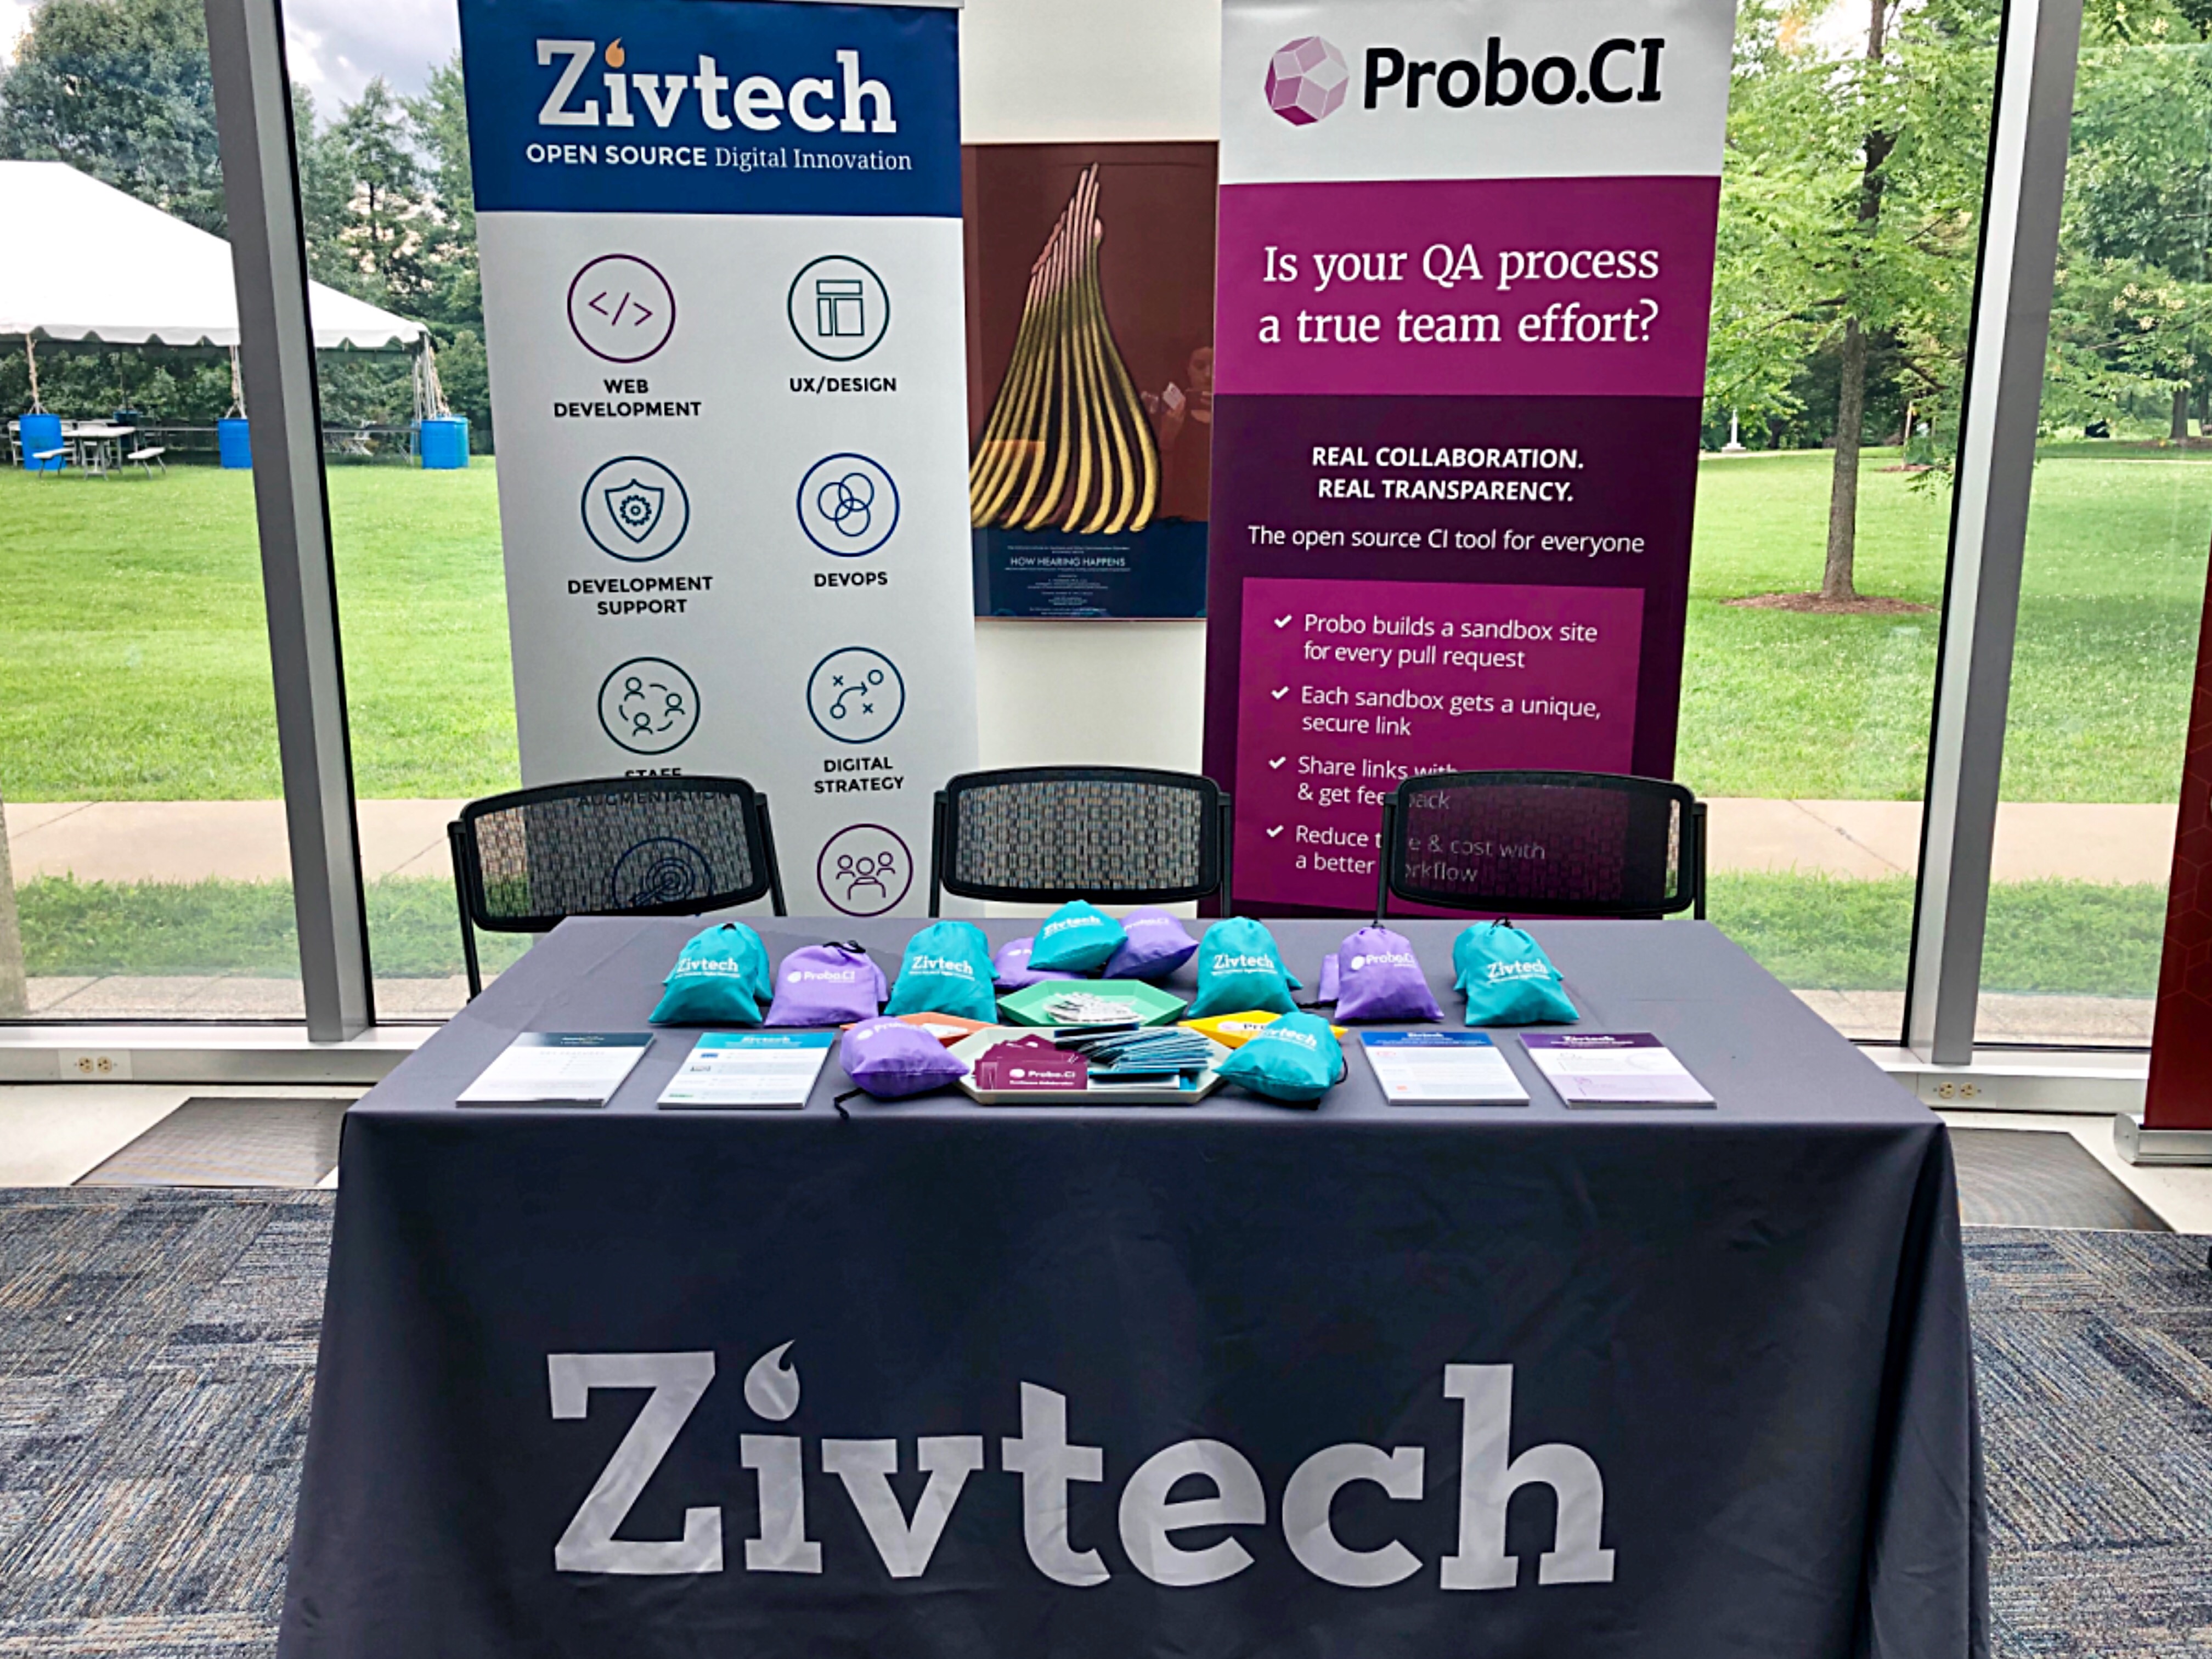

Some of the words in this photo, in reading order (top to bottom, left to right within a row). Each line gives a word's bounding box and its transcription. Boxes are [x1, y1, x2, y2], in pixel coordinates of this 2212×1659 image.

[1364, 37, 1664, 109] Probo.CI
[537, 38, 897, 133] Zivtech
[526, 144, 597, 165] OPEN
[605, 145, 707, 167] SOURCE
[715, 148, 787, 172] Digital
[794, 149, 912, 171] Innovation
[1263, 247, 1298, 281] Is
[1314, 251, 1407, 291] your
[1423, 244, 1482, 287] QA
[1497, 250, 1659, 290] process
[1259, 315, 1280, 342] a
[1297, 309, 1380, 343] true
[1397, 308, 1502, 342] team
[1518, 299, 1659, 342] effort?
[604, 380, 648, 394] WEB
[789, 377, 897, 393] UX/DESIGN
[554, 402, 701, 417] DEVELOPMENT
[1312, 447, 1368, 467] REAL
[1375, 448, 1583, 469] COLLABORATION.
[1318, 479, 1374, 499] REAL
[1383, 481, 1573, 501] TRANSPARENCY.
[1248, 526, 1285, 545] The
[1292, 529, 1344, 550] open
[1352, 531, 1421, 548] source
[1428, 529, 1448, 549] CI
[1455, 529, 1496, 549] tool
[1503, 530, 1534, 550] for
[1541, 534, 1644, 556] everyone
[1011, 557, 1035, 566] HOW
[1037, 557, 1080, 566] HEARING
[1083, 557, 1125, 567] HAPPENS
[568, 577, 713, 595] DEVELOPMENT
[814, 572, 888, 587] DEVOPS
[597, 599, 687, 616] SUPPORT
[1305, 614, 1365, 634] Probo
[1373, 616, 1434, 637] builds
[1442, 623, 1453, 637] a
[1461, 618, 1552, 640] sandbox
[1560, 622, 1598, 642] site
[1305, 640, 1330, 661] for
[1334, 646, 1392, 667] every
[1398, 644, 1436, 666] pull
[1443, 649, 1525, 672] request
[1302, 686, 1348, 707] Each
[1355, 687, 1444, 710] sandbox
[1449, 693, 1494, 715] gets
[1501, 697, 1513, 712] a
[1521, 696, 1601, 720] unique,
[1302, 715, 1369, 734] secure
[1376, 715, 1411, 736] link
[824, 758, 893, 772] DIGITAL
[1298, 756, 1356, 777] Share
[1362, 759, 1408, 780] links
[814, 777, 904, 794] STRATEGY
[1298, 783, 1313, 800] &
[1318, 786, 1351, 806] get
[1296, 825, 1369, 847] Reduce
[1428, 835, 1442, 852] &
[1451, 837, 1493, 857] cost
[1499, 844, 1545, 860] with
[1296, 855, 1307, 869] a
[1314, 852, 1375, 874] better
[912, 955, 973, 975] Zivtech
[1213, 953, 1275, 969] Zivtech
[1487, 958, 1549, 978] Zivtech
[548, 1339, 1616, 1590] Zivtech
